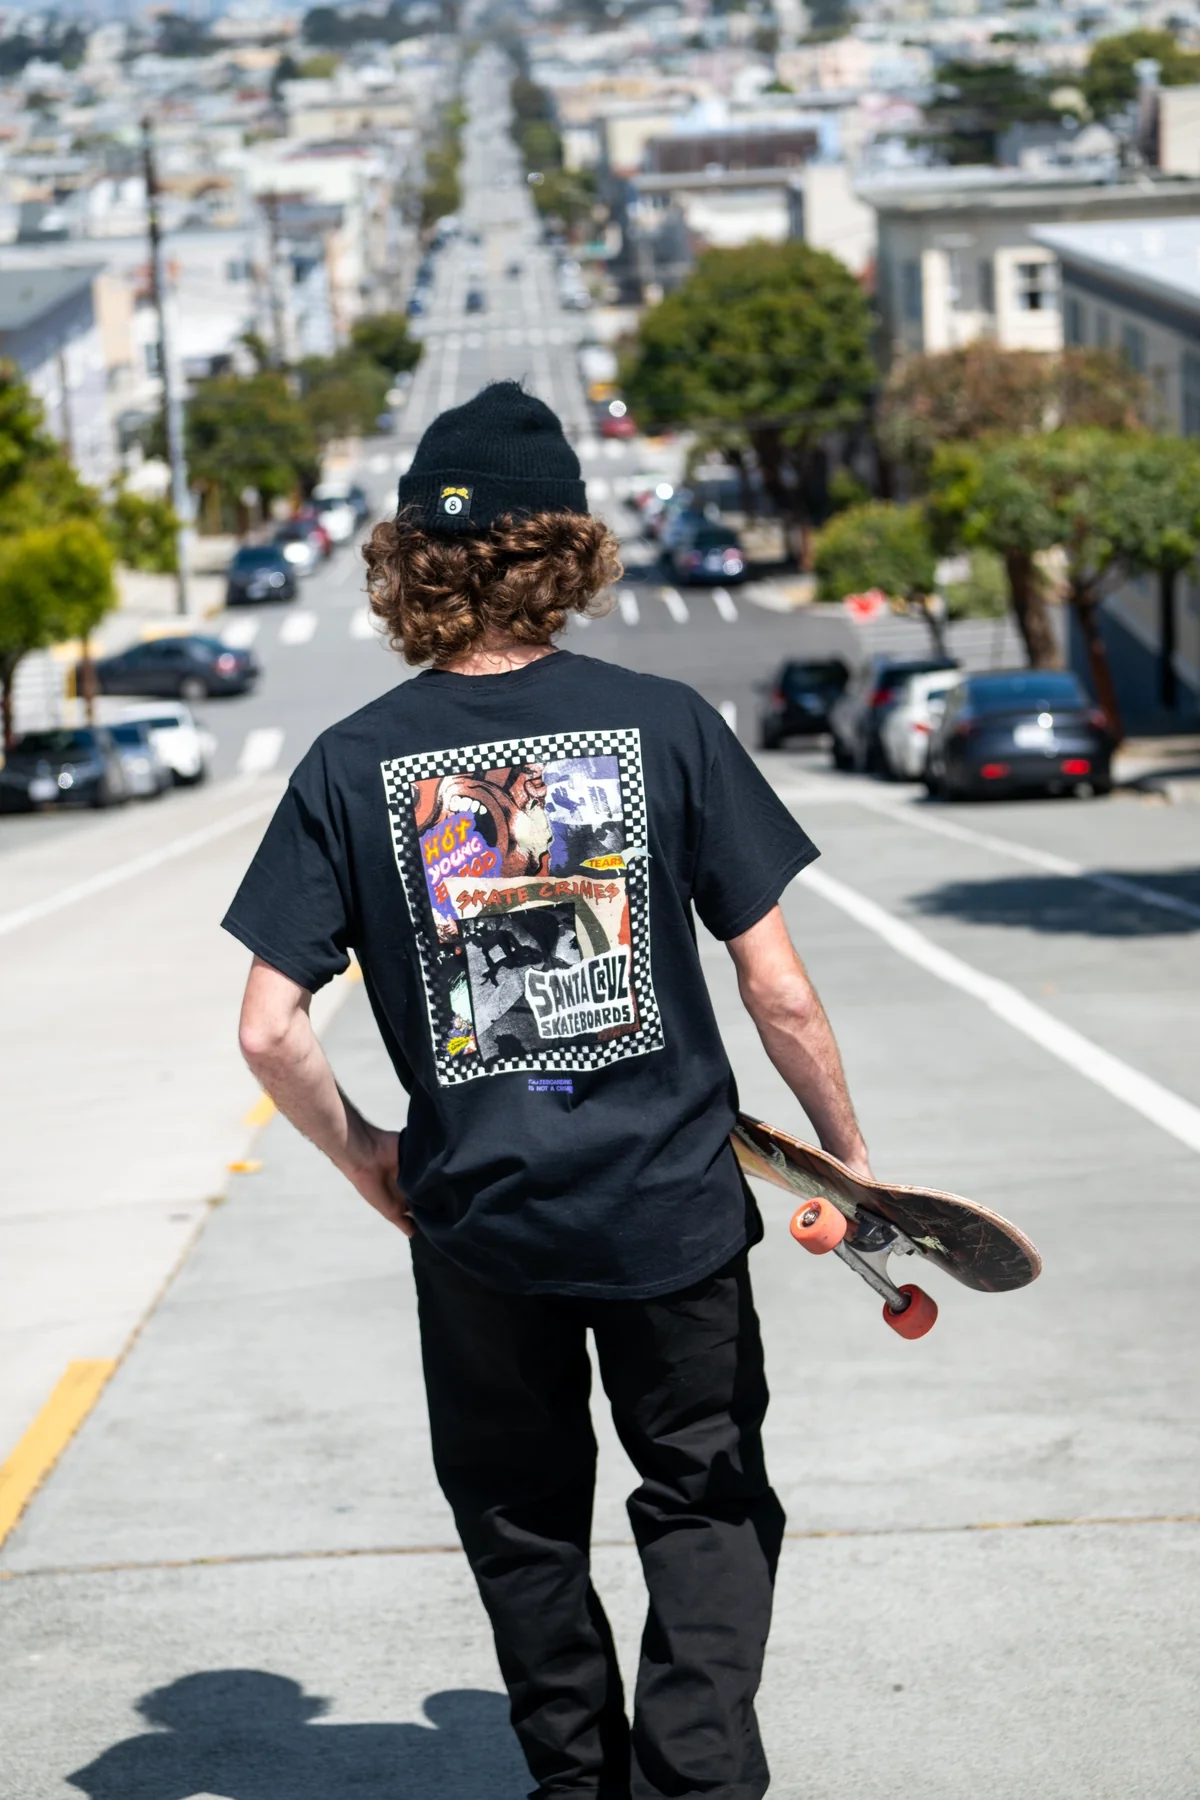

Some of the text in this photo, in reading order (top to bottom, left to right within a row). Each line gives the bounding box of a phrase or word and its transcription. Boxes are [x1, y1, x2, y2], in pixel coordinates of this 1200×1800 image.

[449, 500, 457, 511] 8
[424, 818, 472, 866] HOT
[428, 837, 483, 885] YOUNG
[590, 856, 623, 868] TEARS
[434, 851, 497, 904] BOOD
[456, 880, 620, 912] SKATE CRIMES
[528, 955, 628, 1019] SANTA CRUZ
[540, 1004, 631, 1036] SKATEBOARDS
